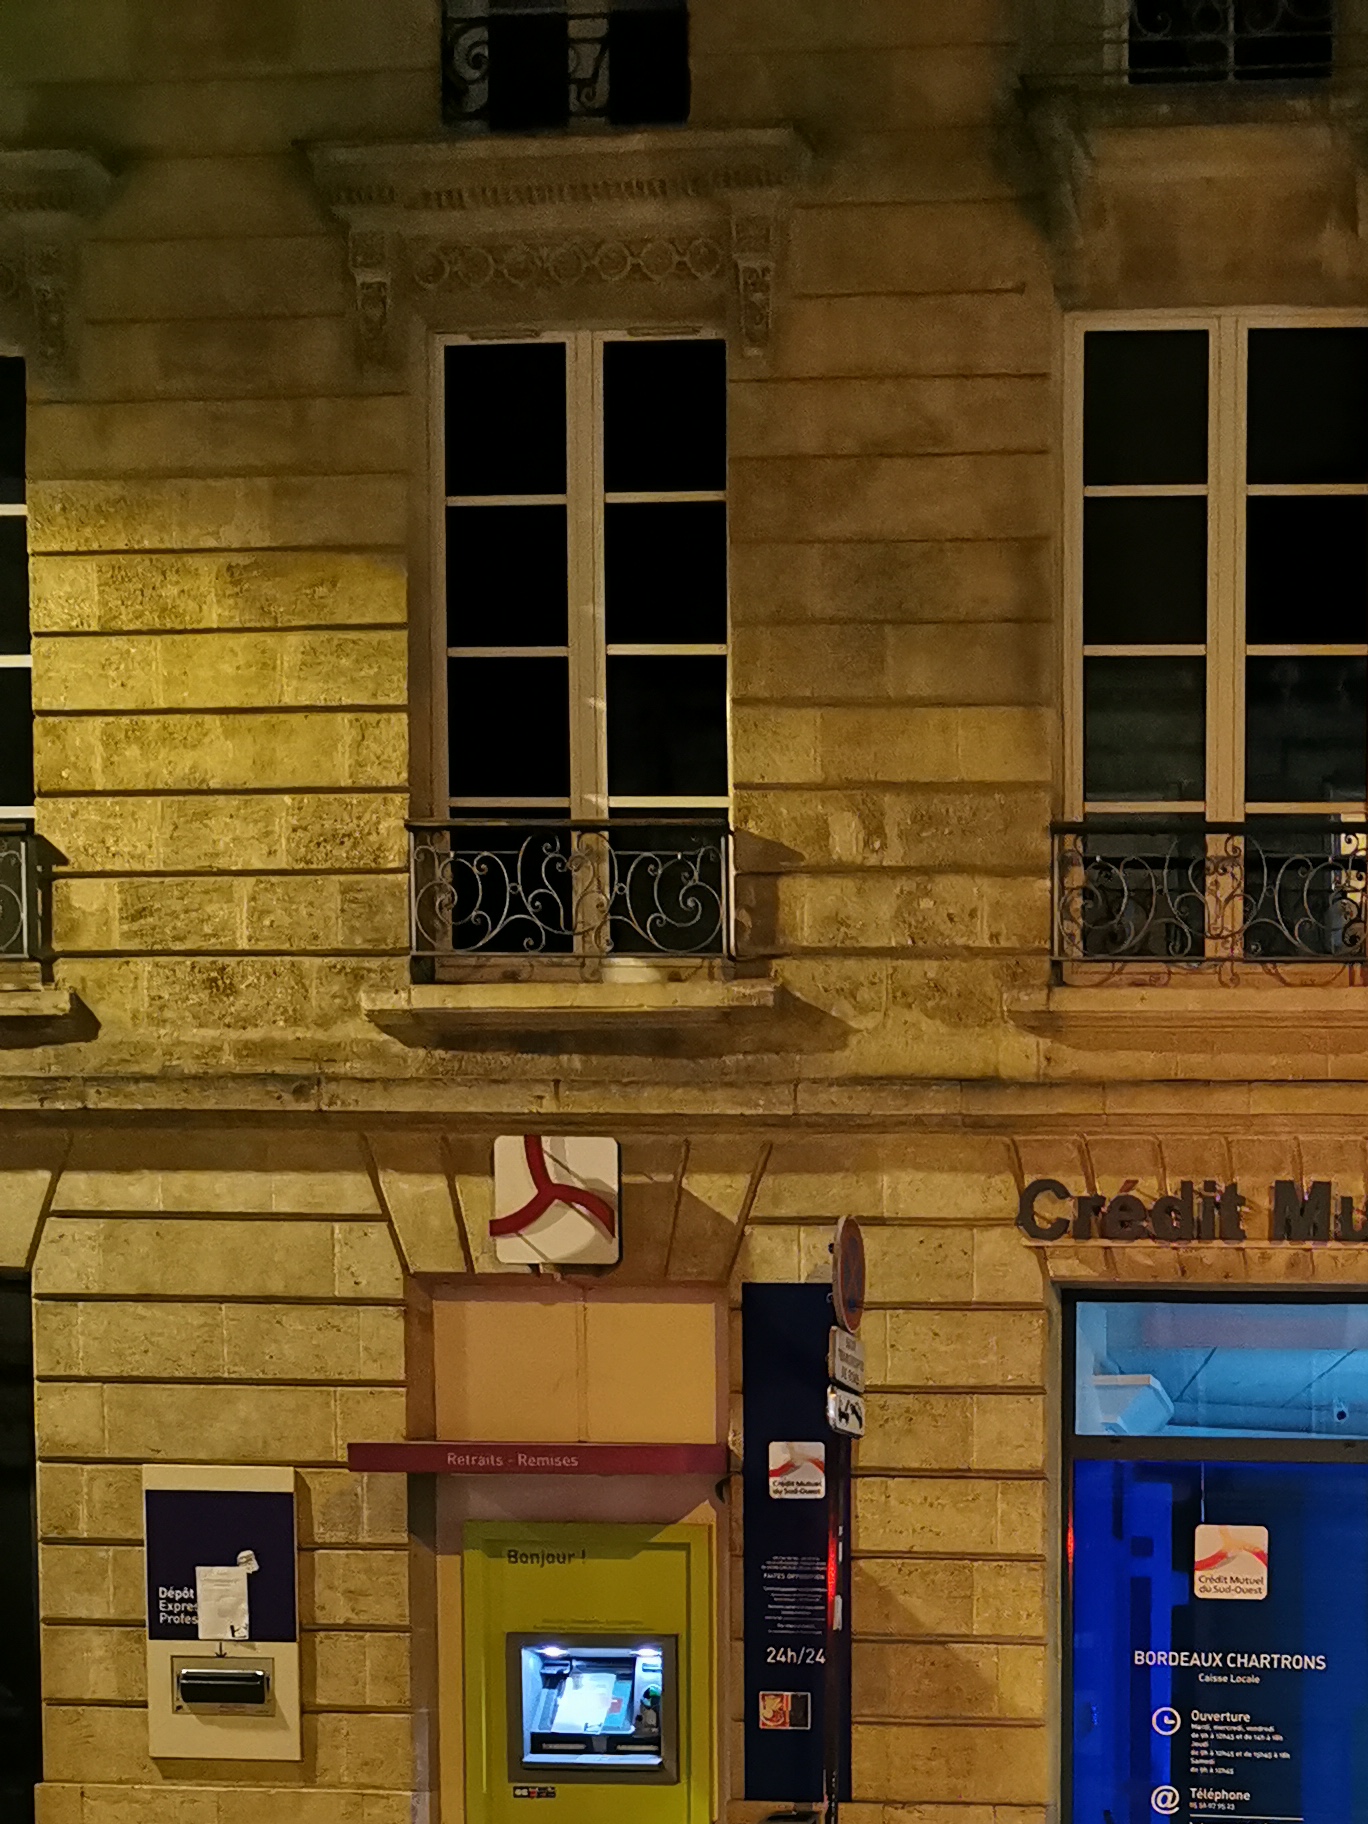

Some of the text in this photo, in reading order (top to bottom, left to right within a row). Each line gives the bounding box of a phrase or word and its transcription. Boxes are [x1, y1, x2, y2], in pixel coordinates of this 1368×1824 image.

[1016, 1178, 1247, 1244] Crédit
[447, 1452, 504, 1467] Retraits
[517, 1453, 579, 1468] Remises
[507, 1550, 576, 1568] Bonjour
[1230, 1576, 1264, 1585] Mutuel
[158, 1586, 195, 1601] Dépôt
[158, 1600, 198, 1613] Expres
[159, 1612, 199, 1625] Profes
[766, 1646, 826, 1665] 24h/24
[1134, 1650, 1327, 1671] BORDEAUX CHARTRONS
[1198, 1672, 1261, 1684] Caisse Locale
[1190, 1710, 1251, 1723] Ouverture
[1189, 1787, 1251, 1802] Téléphone
